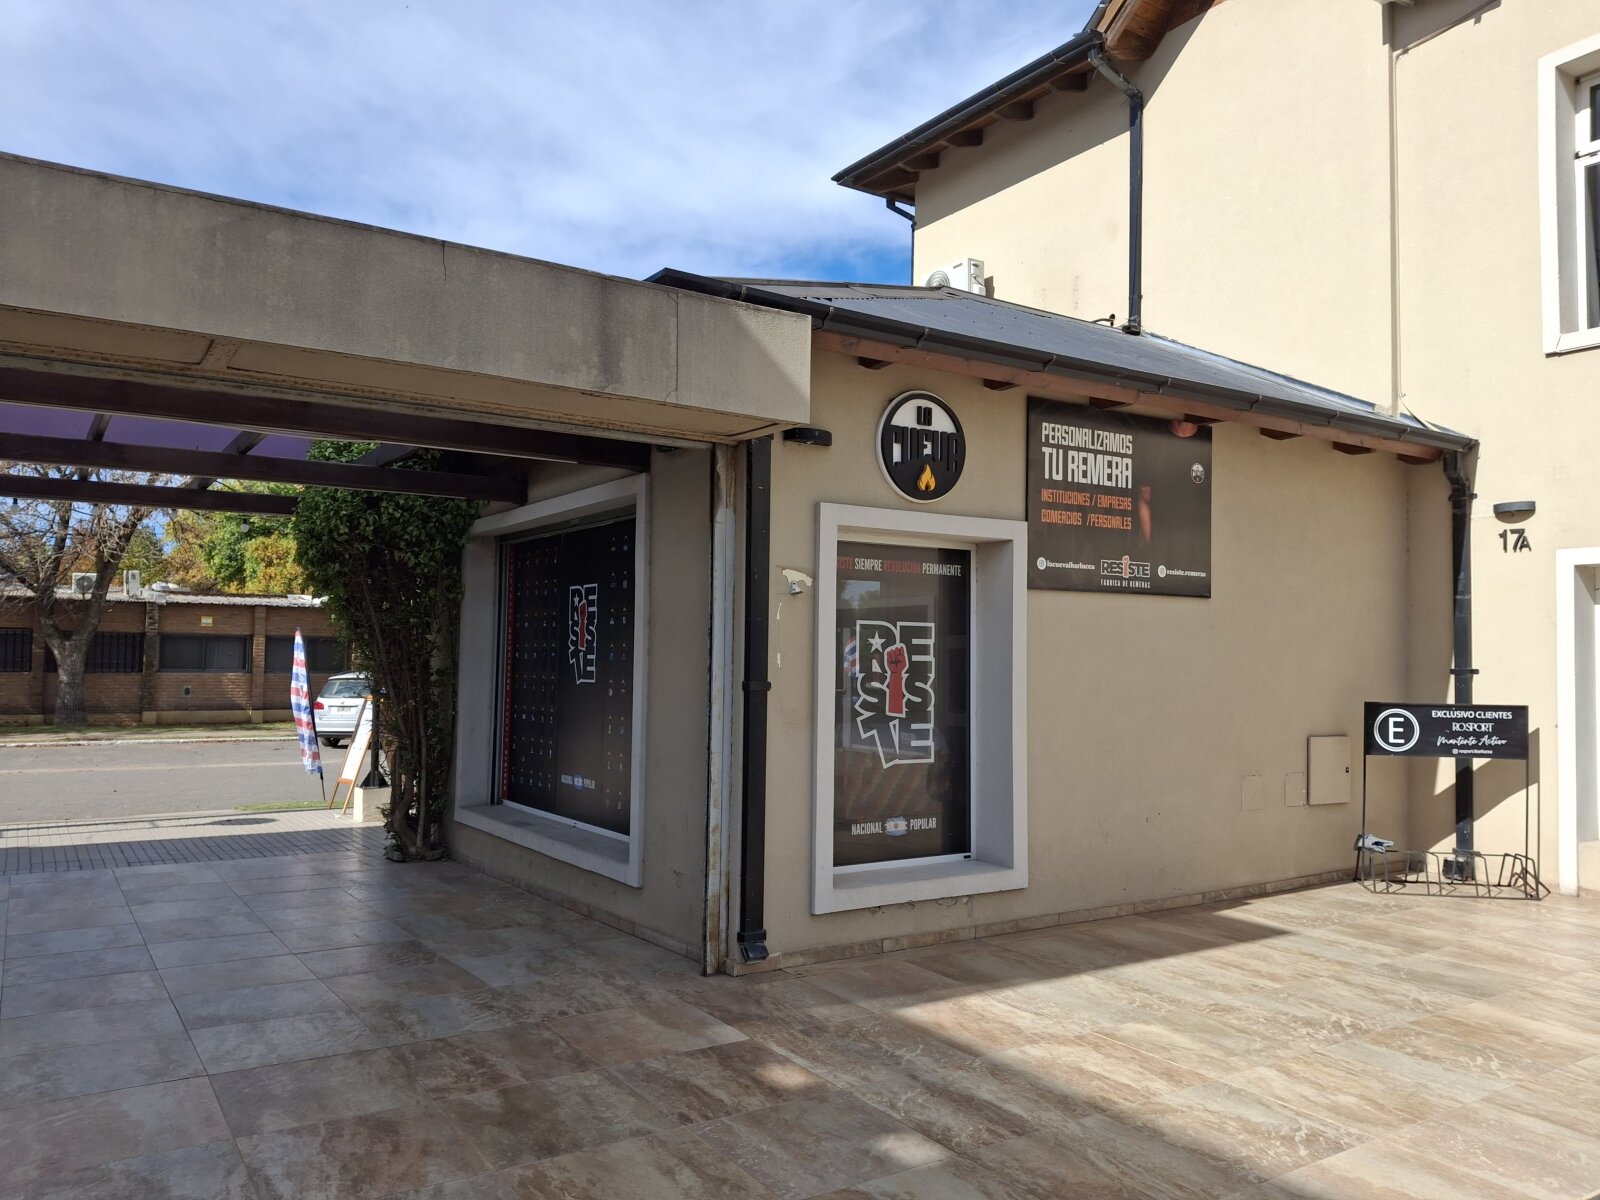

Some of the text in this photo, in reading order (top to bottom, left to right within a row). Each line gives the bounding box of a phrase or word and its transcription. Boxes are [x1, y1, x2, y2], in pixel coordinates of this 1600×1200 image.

[916, 406, 932, 426] LA
[1042, 422, 1133, 454] PERSONALIZAMOS
[1042, 446, 1132, 489] TU REMERA
[1041, 488, 1090, 506] INSTITUCIONES
[1097, 494, 1132, 510] EMPRESAS
[1041, 509, 1082, 525] COMERCIOS
[854, 558, 883, 571] SIEMPRE
[922, 563, 962, 577] PERMANENTE
[1431, 710, 1513, 720] EXCLUSIVO CLIENTES
[1388, 717, 1406, 744] E
[1452, 722, 1494, 733] ROSPORT
[1478, 734, 1508, 746] Activo
[851, 817, 937, 836] NACIONAL POPULAR
